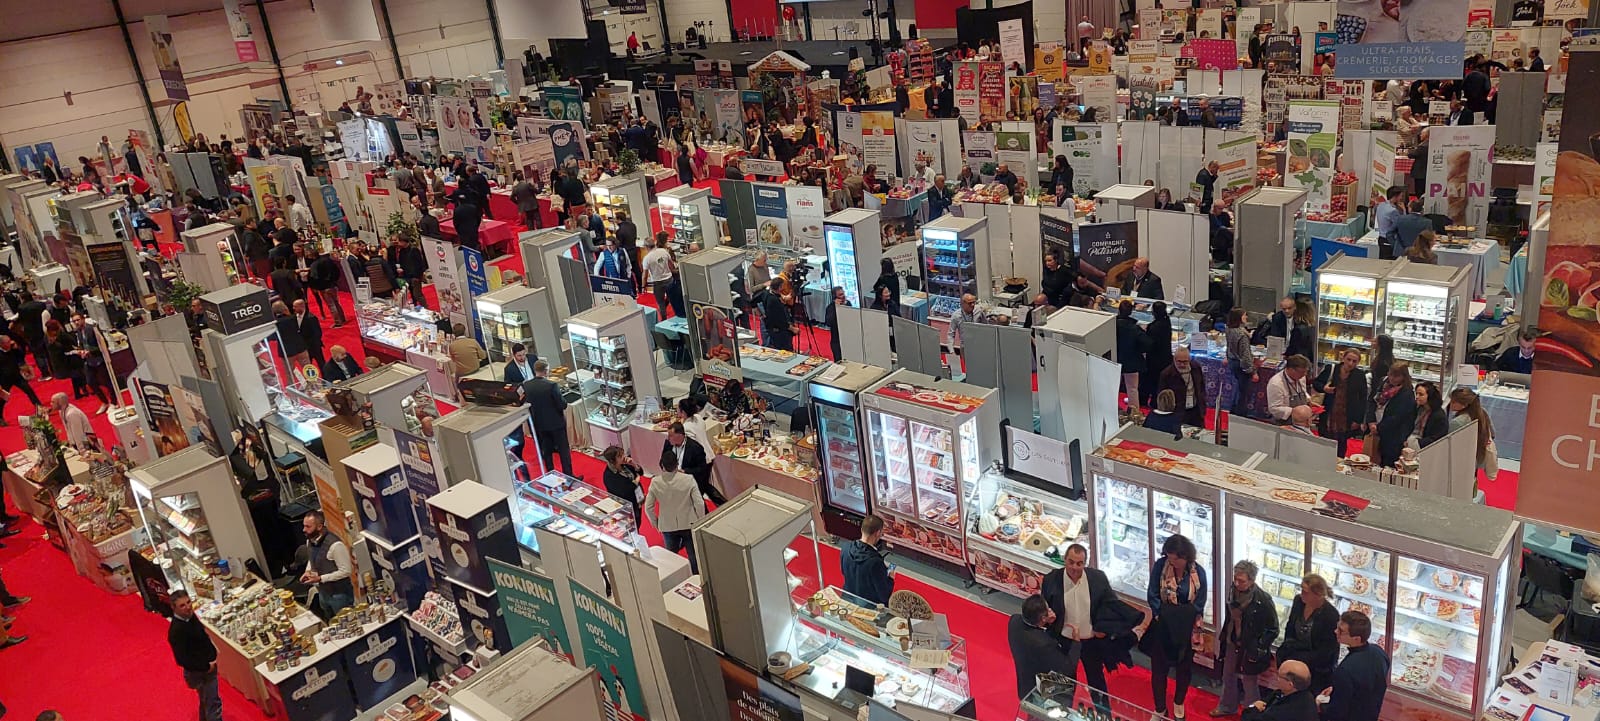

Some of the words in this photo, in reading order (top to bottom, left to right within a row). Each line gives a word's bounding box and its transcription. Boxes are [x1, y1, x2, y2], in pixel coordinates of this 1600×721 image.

[1361, 46, 1435, 56] ULTRA-FRAIS,
[1396, 55, 1461, 65] FROMAGES,
[1430, 183, 1485, 198] PAIN
[797, 199, 813, 207] rians
[1092, 240, 1125, 248] COMPAGNIE
[231, 304, 262, 320] TREO
[494, 571, 555, 605] KOKIRIKI
[573, 590, 626, 637] KOKIRIKI
[586, 622, 606, 640] 100%
[742, 690, 758, 705] Des
[759, 701, 780, 718] plats
